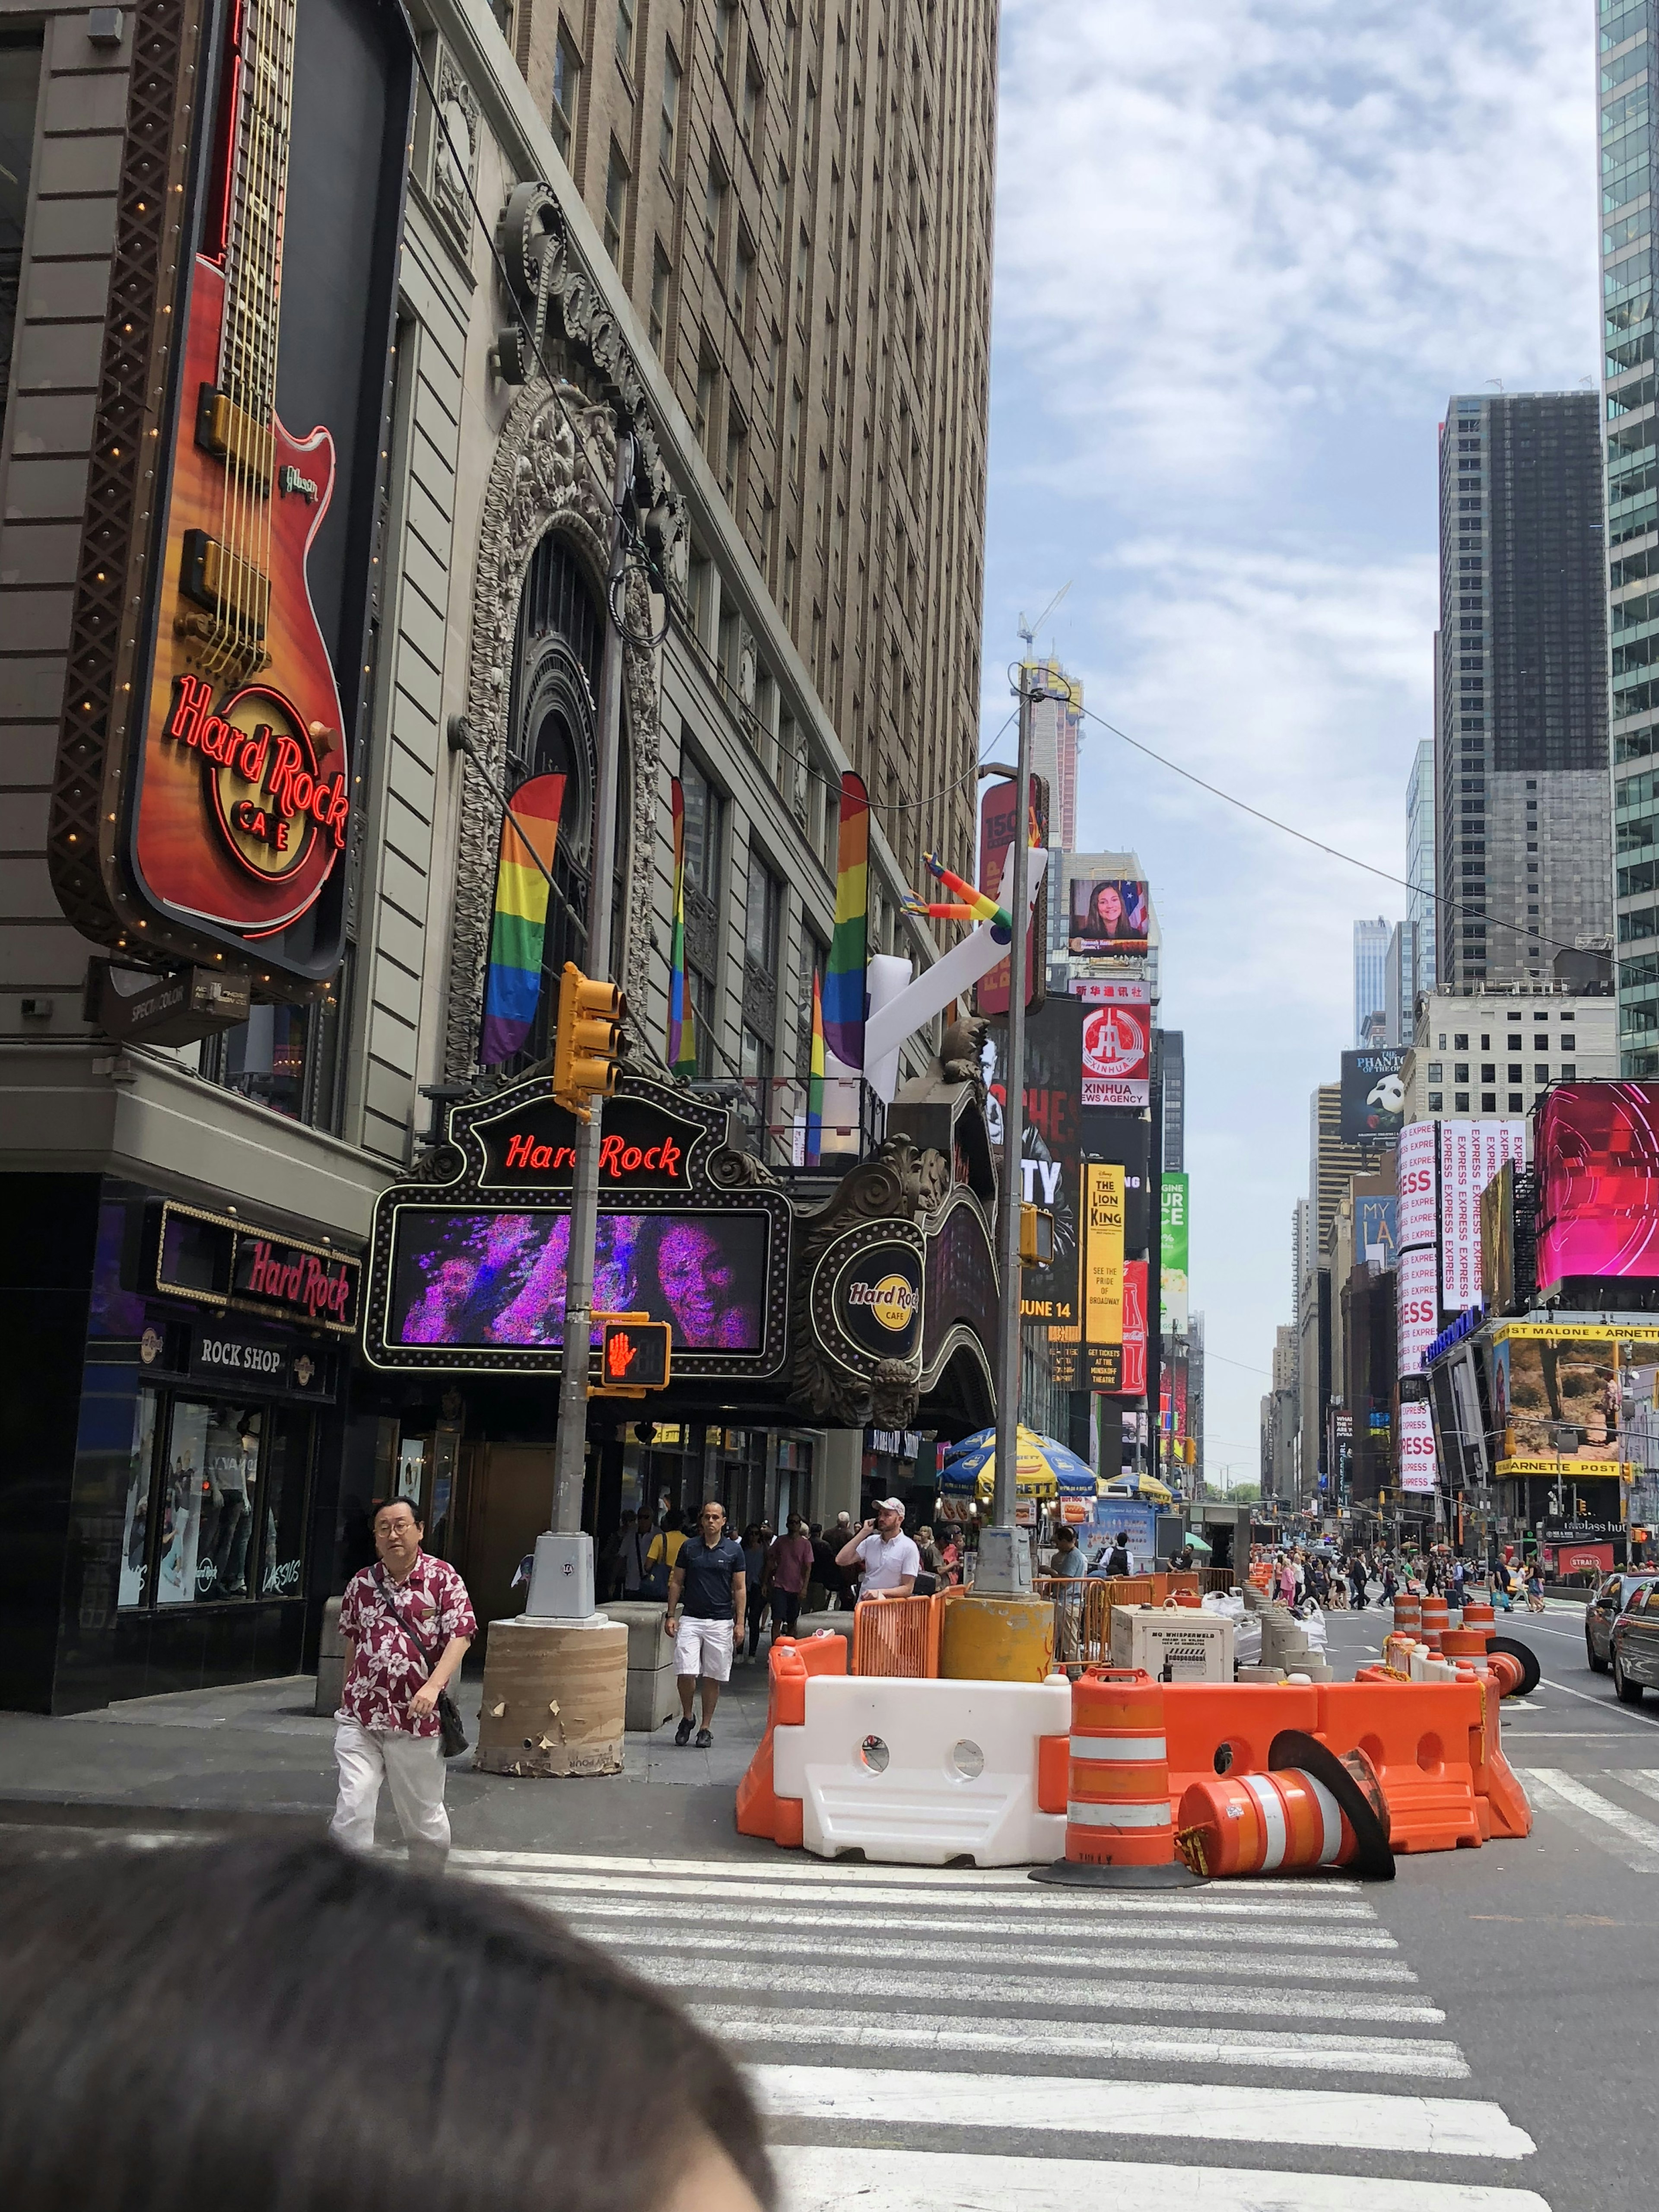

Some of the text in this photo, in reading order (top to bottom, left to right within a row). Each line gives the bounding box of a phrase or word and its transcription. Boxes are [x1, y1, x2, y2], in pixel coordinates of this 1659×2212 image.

[171, 675, 350, 849] Hard Rock
[1090, 1061, 1129, 1073] XINHUA
[1357, 1055, 1405, 1068] PHANT
[1084, 1084, 1132, 1094] XINHUA
[598, 1135, 681, 1177] Rock
[1444, 1129, 1452, 1178] EXPRESS
[1458, 1136, 1467, 1185] EXPRESS
[1471, 1129, 1481, 1178] EXPRESS
[1096, 1181, 1114, 1190] THE
[1161, 1184, 1184, 1192] GINE
[1161, 1193, 1183, 1207] UR
[1363, 1202, 1390, 1219] MY
[1445, 1185, 1453, 1233] EXPRESS
[1161, 1208, 1184, 1226] CE
[1459, 1192, 1468, 1241] EXPRESS
[1445, 1240, 1454, 1290] EXPRESS
[1459, 1247, 1468, 1297] EXPRESS
[1474, 1241, 1482, 1291] EXPRESS
[248, 1241, 350, 1322] Hard Rock
[849, 1282, 895, 1305] Hard
[1089, 1297, 1120, 1305] BROADWAY
[886, 1312, 904, 1320] CAFE
[1020, 1299, 1071, 1318] JUNE 14
[201, 1339, 241, 1366] ROCK
[244, 1347, 280, 1373] SHOP
[1092, 1376, 1116, 1384] THEATRE
